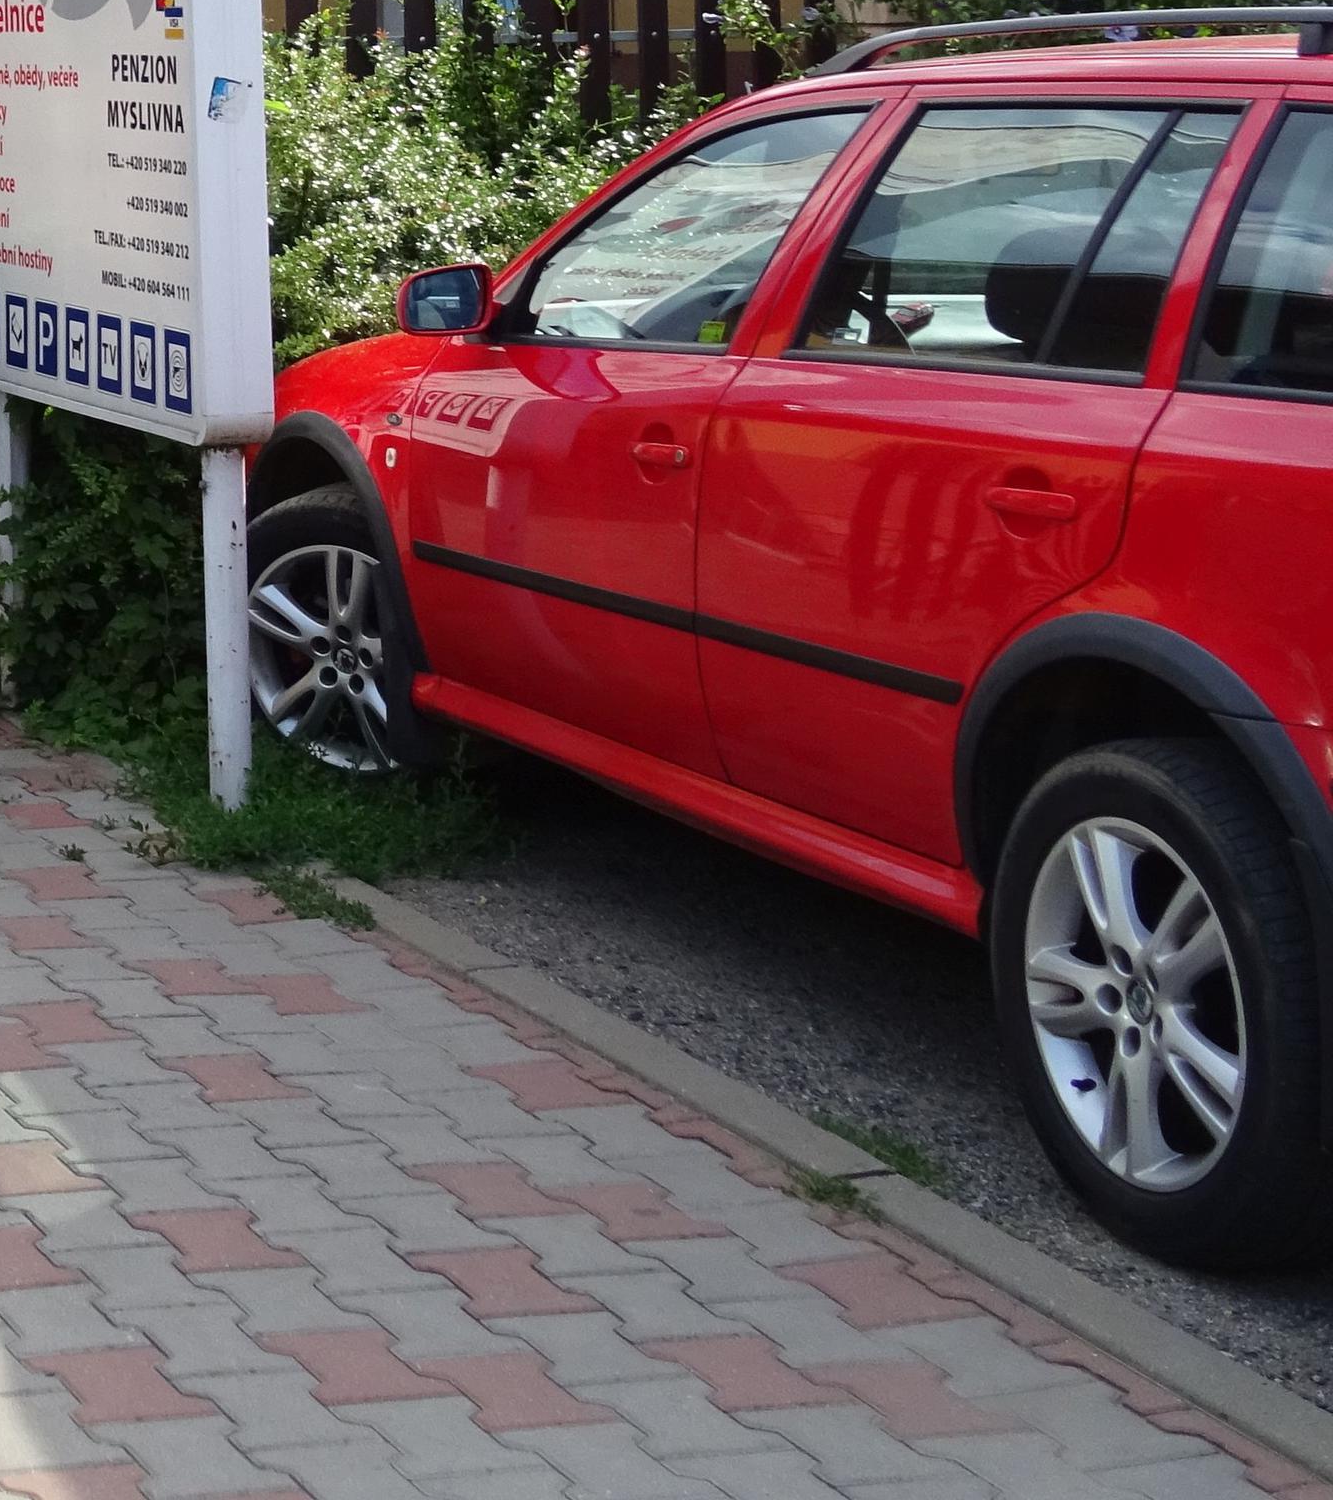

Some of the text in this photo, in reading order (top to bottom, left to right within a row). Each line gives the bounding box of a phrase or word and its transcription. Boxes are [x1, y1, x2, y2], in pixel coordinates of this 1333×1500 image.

[14, 63, 45, 91] obědy,
[47, 65, 79, 88] večeře
[111, 54, 178, 85] PENZION
[107, 100, 185, 134] MYSLIVNA
[125, 155, 143, 171] +420
[144, 157, 157, 173] 519
[158, 158, 172, 174] 340
[173, 160, 187, 176] 220
[126, 196, 188, 218] +420 519 340 002
[18, 245, 53, 277] hostiny
[127, 236, 145, 252] +420
[146, 238, 159, 254] 519
[160, 240, 174, 257] 340
[175, 243, 189, 260] 212
[101, 269, 190, 302] MOBIL: +420 604 564 111
[102, 342, 117, 367] TV
